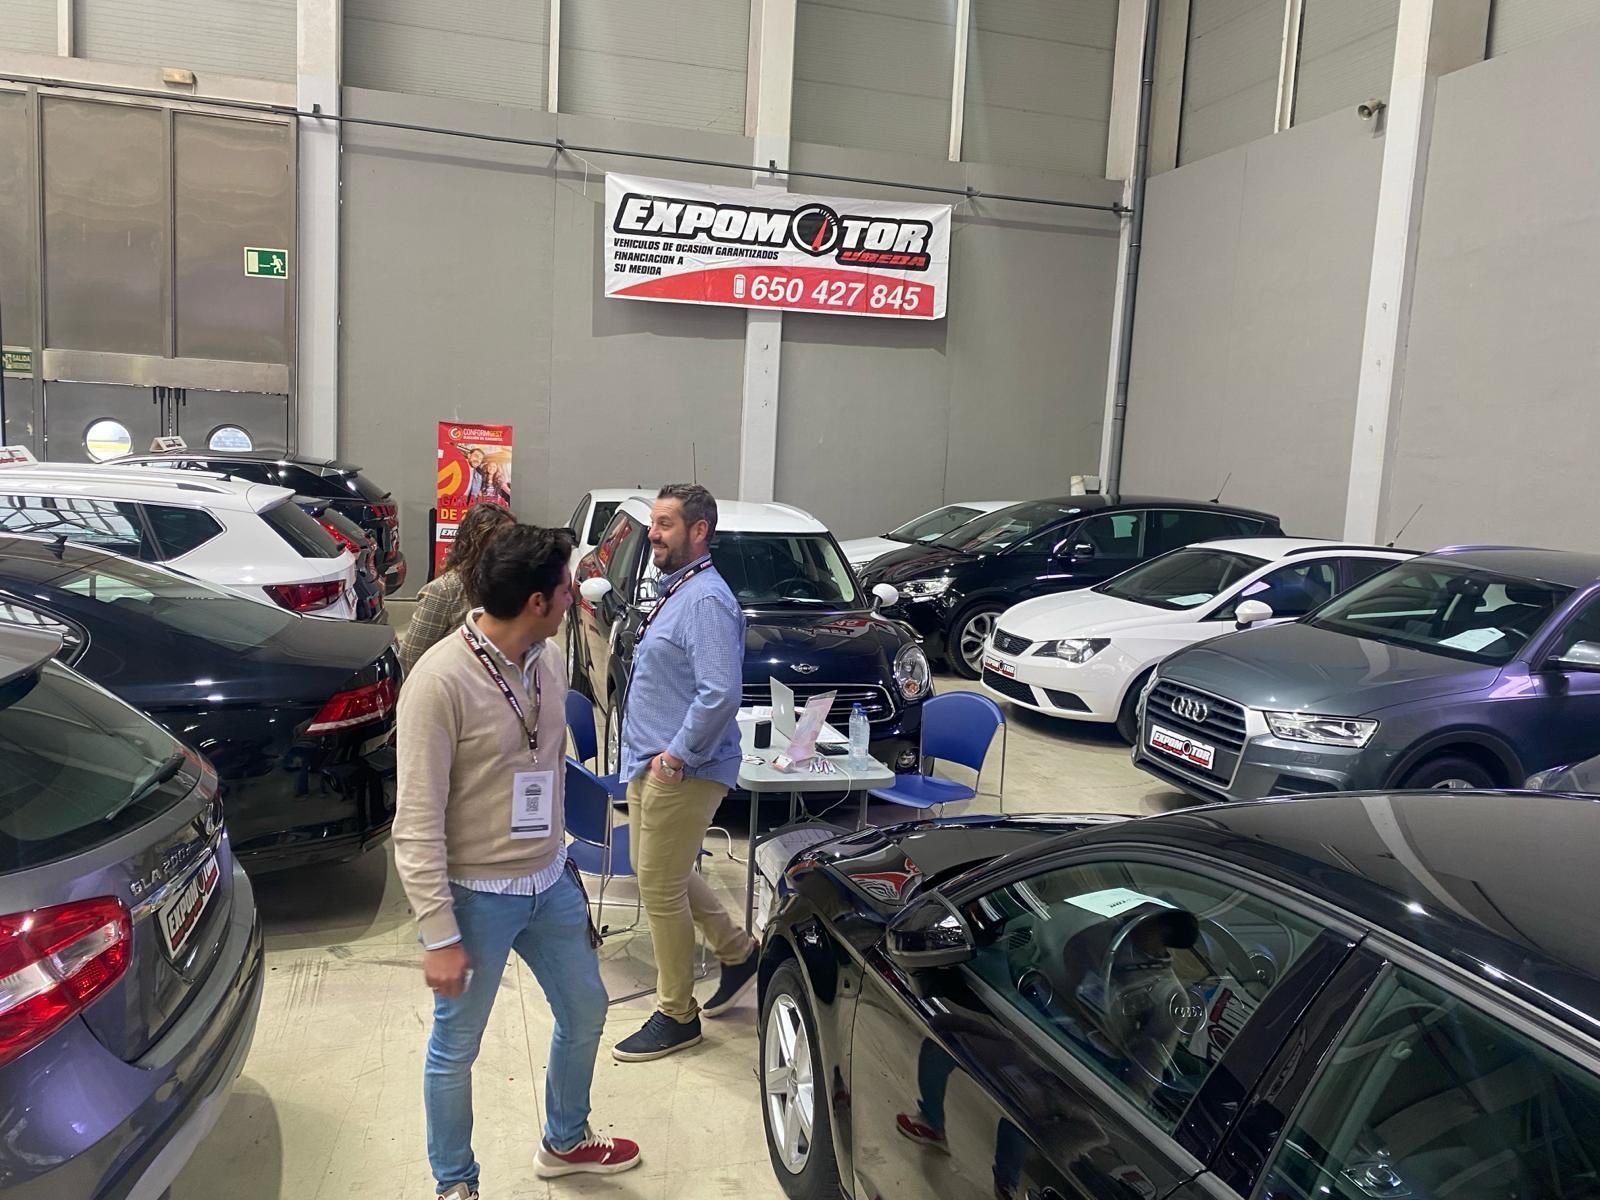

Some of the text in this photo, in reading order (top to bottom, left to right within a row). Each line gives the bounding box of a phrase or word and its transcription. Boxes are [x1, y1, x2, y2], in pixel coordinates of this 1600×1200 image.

[613, 238, 779, 260] VEHICULOS DE OCASION GARANTIZADOS
[614, 251, 684, 265] FINANCIACION A
[614, 263, 662, 276] SU MEDIDA
[750, 275, 921, 311] 650 427 845
[440, 508, 458, 520] DE
[131, 868, 161, 896] GLA
